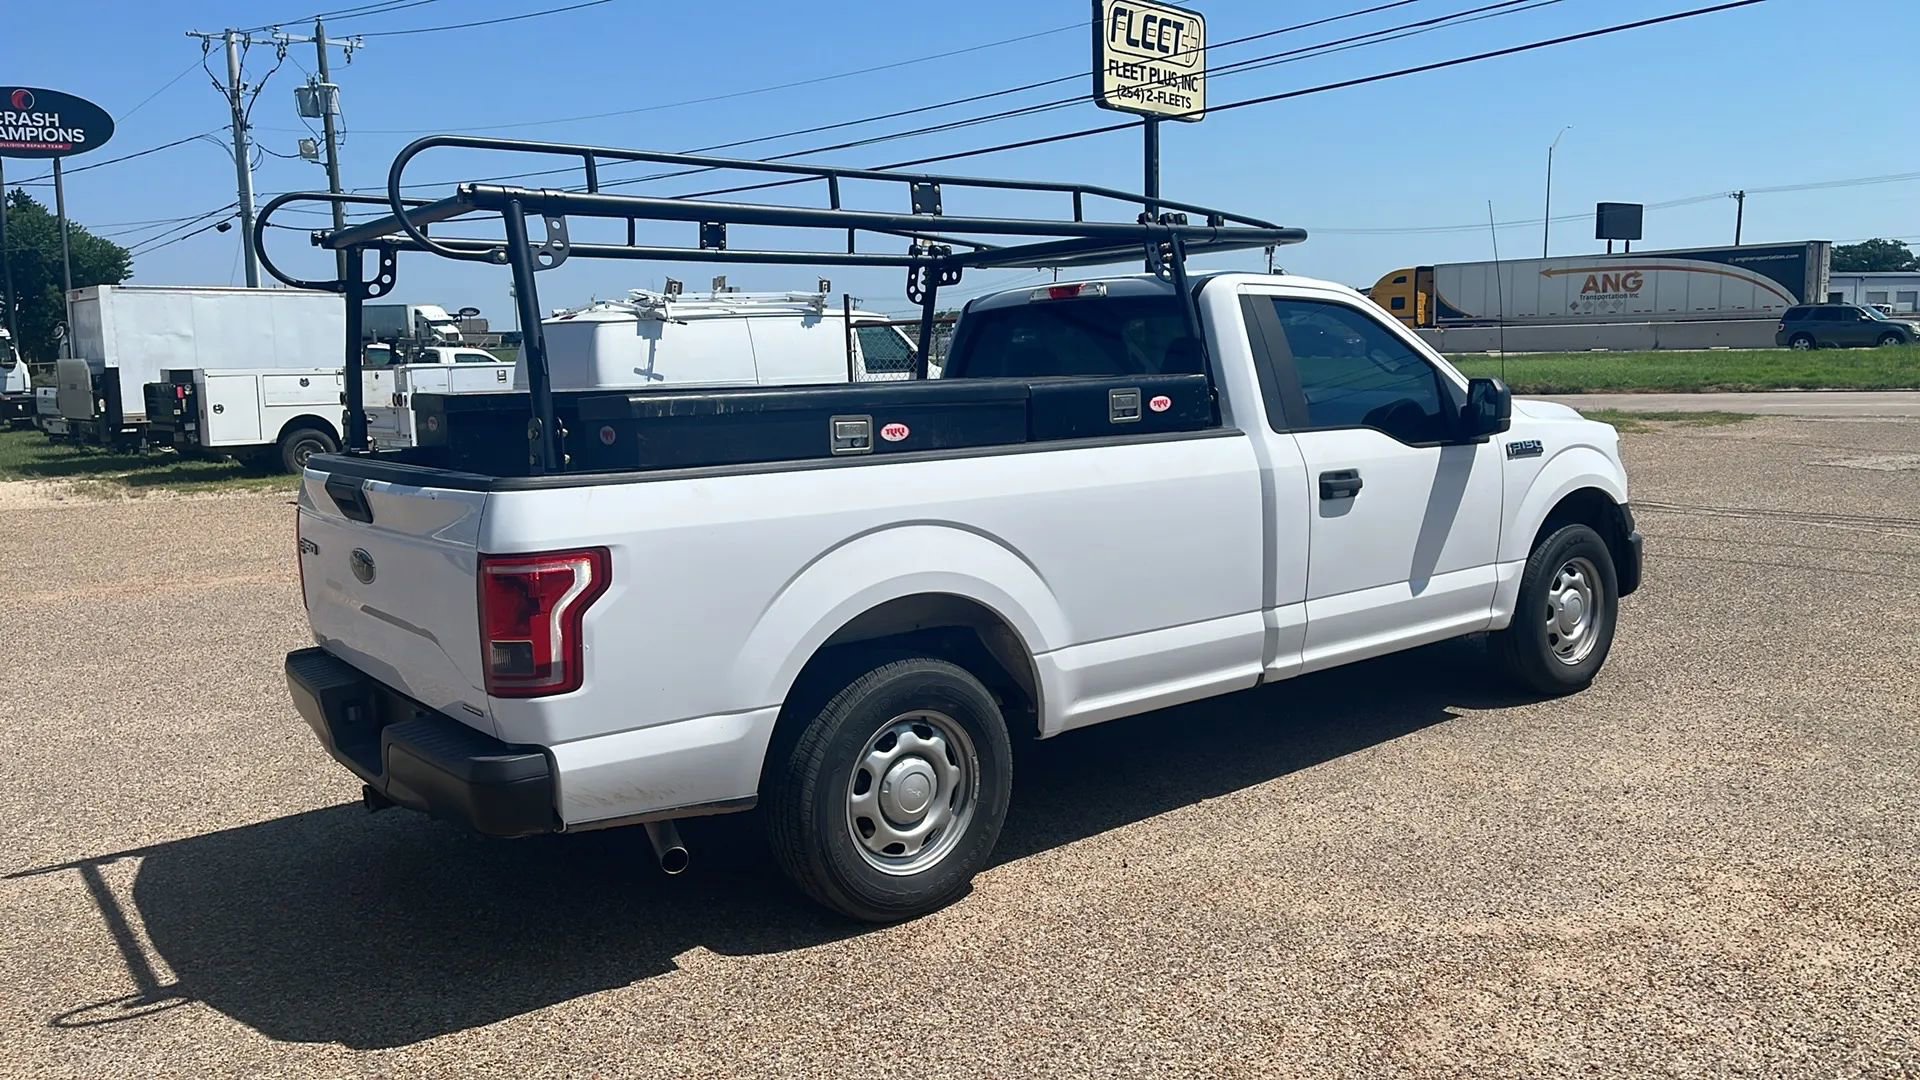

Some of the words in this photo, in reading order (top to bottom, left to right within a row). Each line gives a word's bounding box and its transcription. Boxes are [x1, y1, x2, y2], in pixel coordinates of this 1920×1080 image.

[1111, 7, 1184, 55] FLEET
[1109, 59, 1147, 82] FLEET
[1117, 84, 1144, 104] (254)
[1146, 89, 1192, 109] 2-FLEETS
[1581, 271, 1643, 293] ANG
